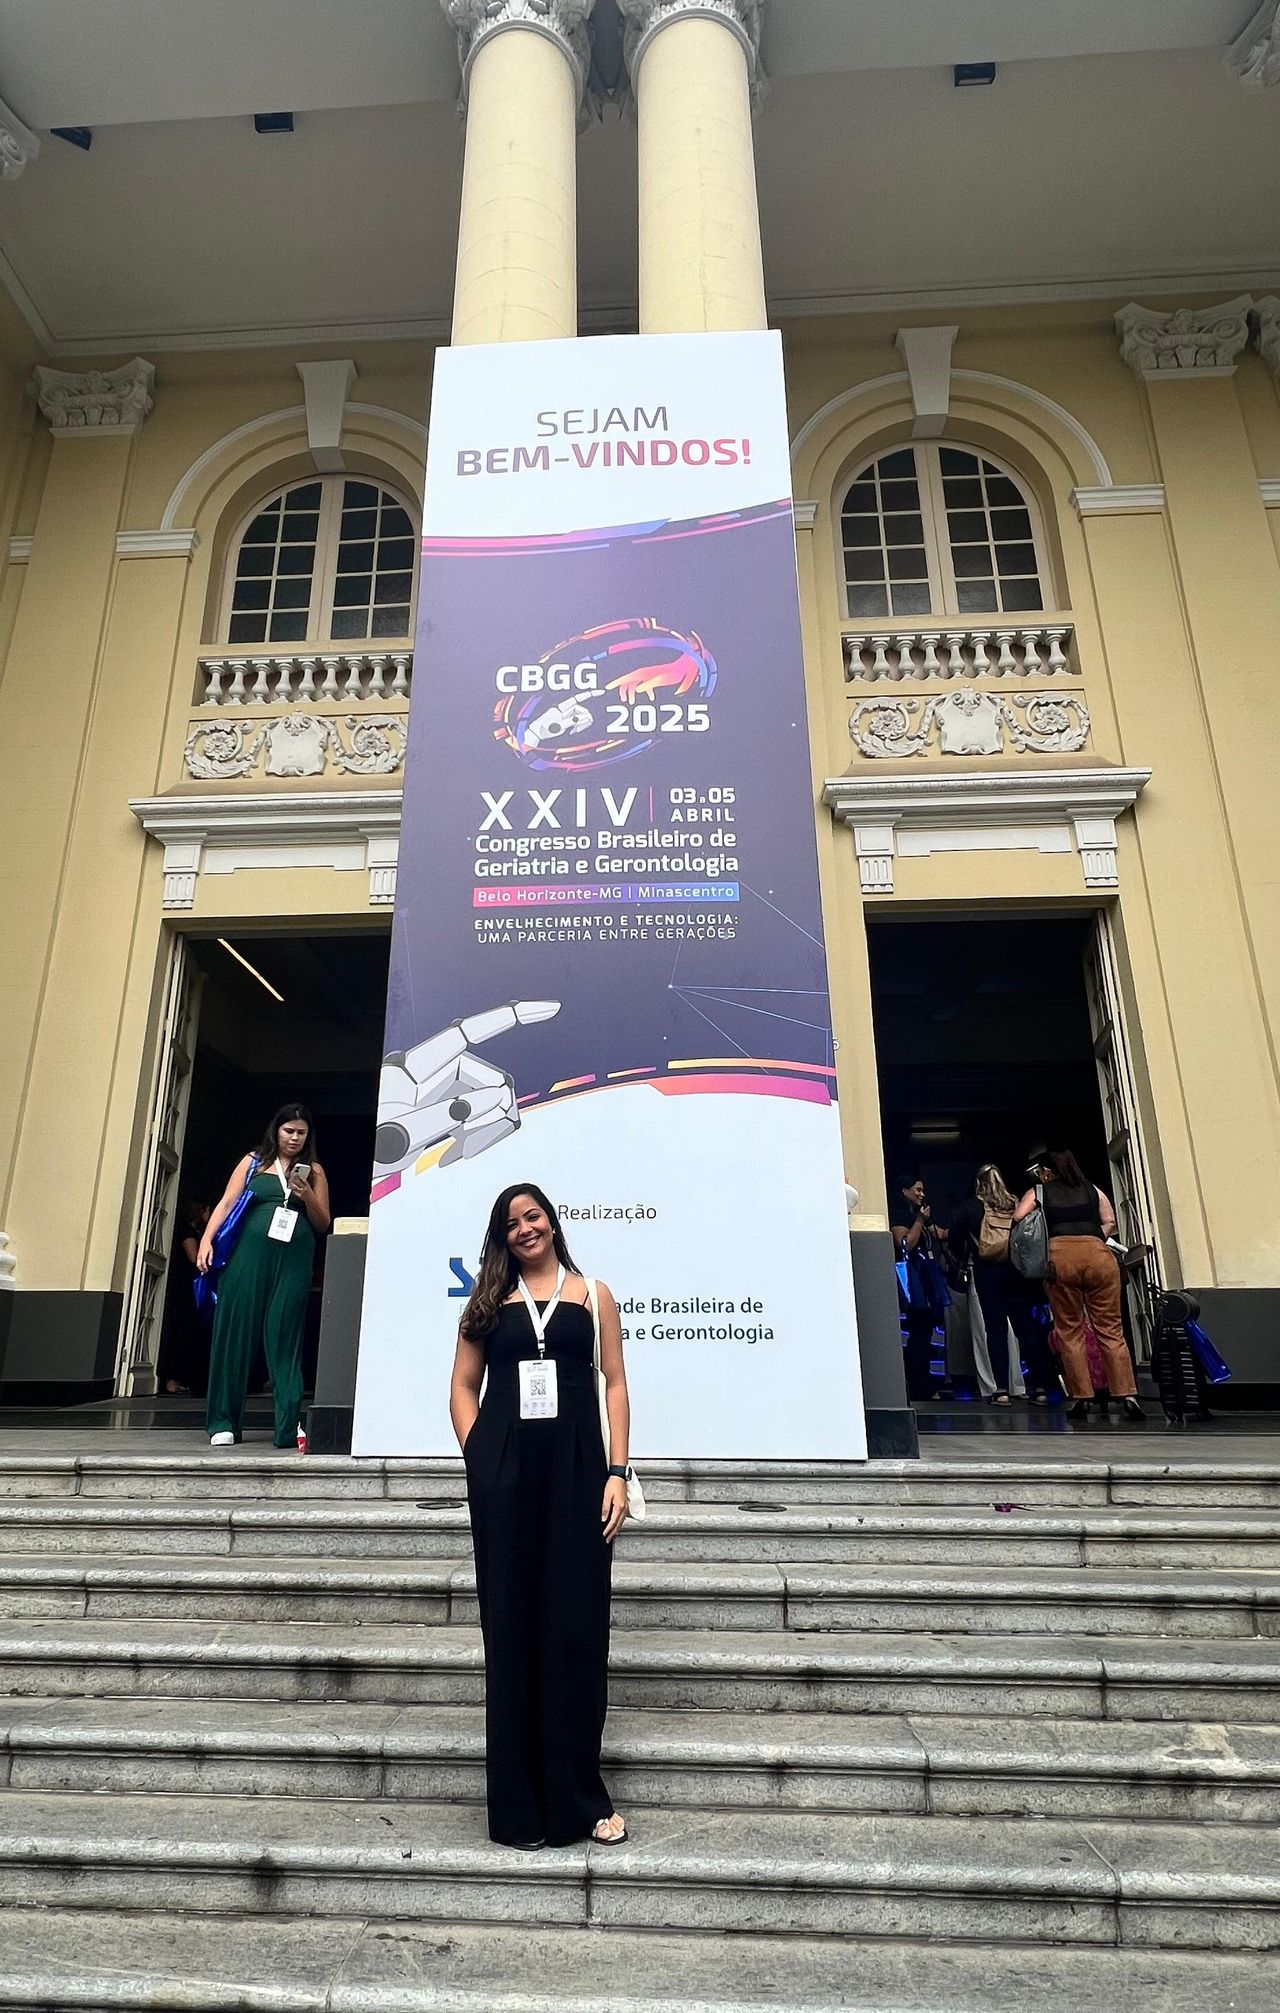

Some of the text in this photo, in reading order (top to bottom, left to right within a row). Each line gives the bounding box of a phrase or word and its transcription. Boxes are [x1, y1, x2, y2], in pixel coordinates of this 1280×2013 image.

[537, 406, 668, 436] SEJAM
[456, 438, 750, 476] BEM-VINDOS!
[495, 662, 597, 692] CBGG
[606, 704, 710, 733] 2025
[670, 808, 735, 822] ABRIL
[475, 828, 736, 857] Congresso Brasileiro de
[474, 852, 739, 877] Geriatria e Gerontologia
[478, 891, 511, 903] Belo
[517, 887, 622, 901] Horizonte-MG
[638, 886, 734, 899] Minascentro
[474, 913, 739, 930] ENVELHECIMENTO E TECNOLOGIA:
[478, 926, 736, 943] UMA PARCERIA ENTRE GERAÇÕES
[558, 1204, 657, 1224] Realização
[651, 1297, 735, 1314] Brasileira
[740, 1297, 763, 1313] de
[636, 1328, 645, 1340] e
[651, 1323, 774, 1344] Gerontologia
